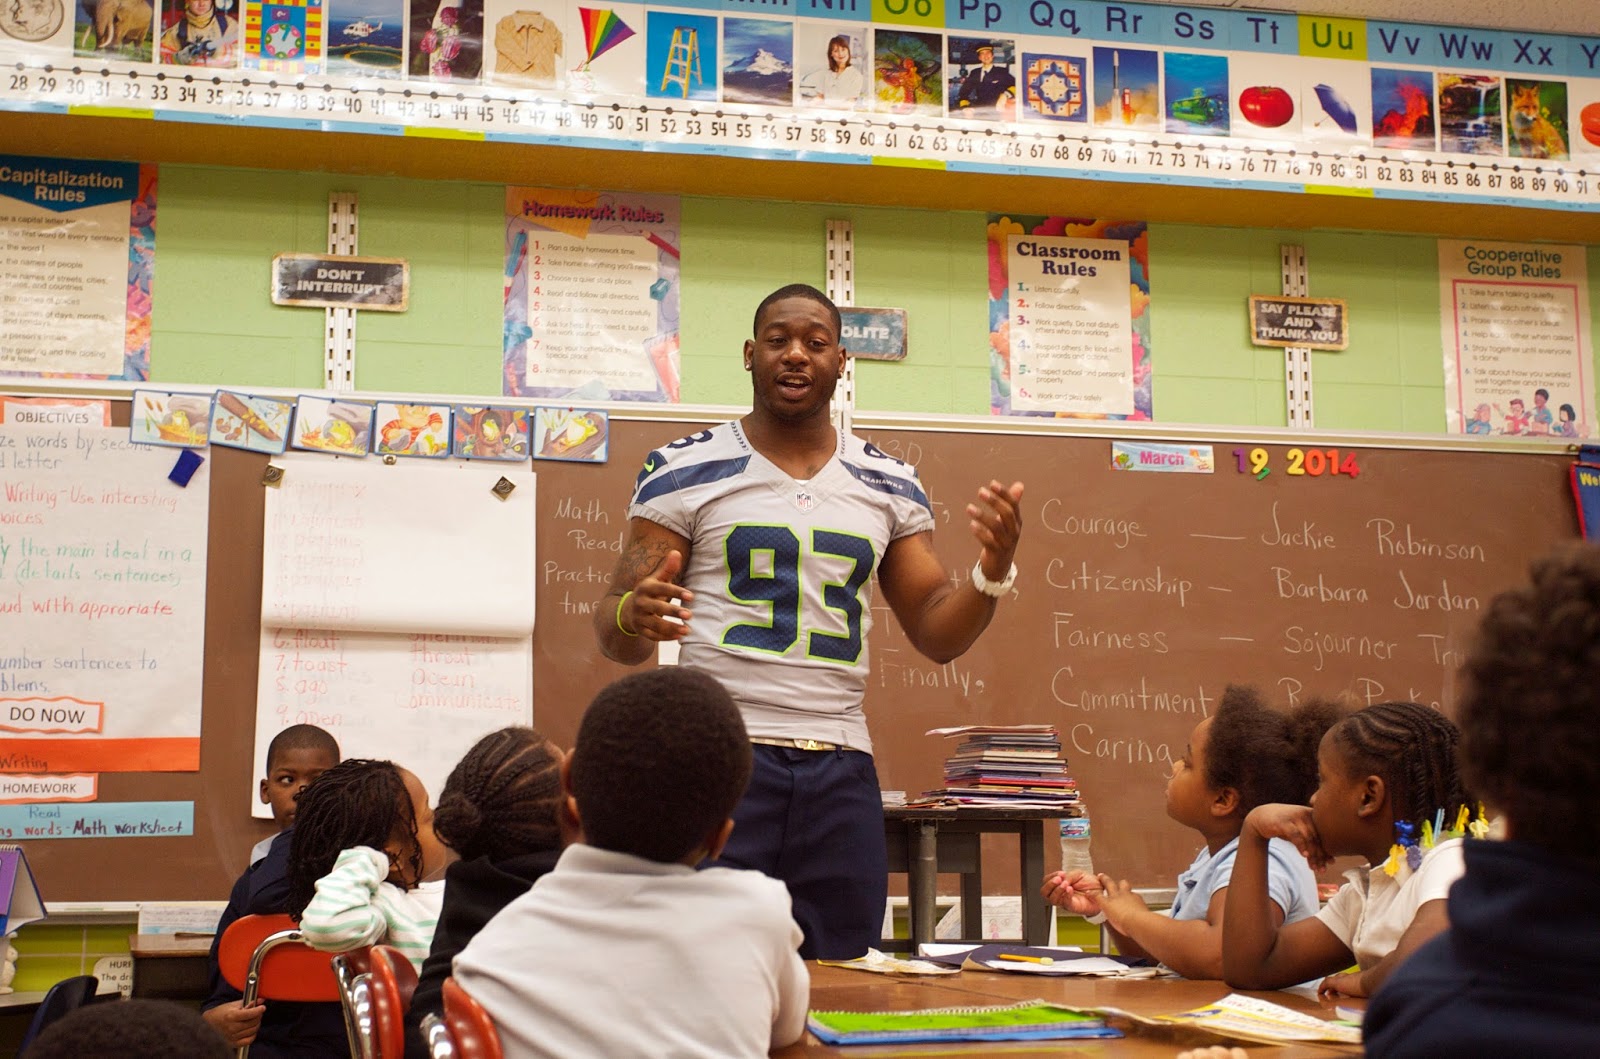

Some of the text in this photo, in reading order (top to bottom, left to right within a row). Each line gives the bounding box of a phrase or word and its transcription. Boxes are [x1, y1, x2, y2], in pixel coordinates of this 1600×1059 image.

[959, 0, 1002, 28] Pp
[1030, 0, 1081, 35] Qq
[1106, 6, 1143, 33] Rr
[1174, 12, 1215, 40] Ss
[1247, 17, 1279, 44] Tt
[1312, 22, 1353, 50] Uu
[1378, 28, 1420, 55] Vv
[1440, 33, 1493, 61] Ww
[1513, 38, 1554, 66] Xx
[10, 75, 28, 90] 28
[151, 84, 168, 100] 33
[178, 87, 196, 102] 34
[206, 88, 224, 105] 35
[344, 98, 362, 113] 40
[424, 102, 441, 118] 43
[451, 104, 468, 120] 44
[477, 106, 494, 121] 45
[581, 113, 598, 129] 49
[608, 115, 623, 130] 50
[636, 117, 648, 132] 51
[661, 119, 676, 133] 52
[686, 120, 702, 135] 53
[711, 122, 727, 136] 54
[736, 123, 752, 138] 55
[786, 127, 802, 141] 57
[860, 132, 875, 146] 60
[885, 134, 897, 148] 61
[909, 135, 924, 150] 62
[933, 136, 948, 151] 63
[1030, 144, 1045, 158] 67
[1054, 146, 1069, 160] 68
[1078, 147, 1092, 162] 69
[1378, 167, 1392, 181] 82
[1400, 168, 1414, 182] 83
[1422, 170, 1437, 185] 84
[1444, 172, 1458, 185] 85
[1466, 173, 1480, 187] 86
[1488, 174, 1502, 188] 87
[1510, 176, 1525, 190] 88
[1532, 178, 1546, 192] 89
[1554, 179, 1568, 193] 90
[1577, 180, 1587, 194] 91
[0, 166, 124, 188] Capitalization
[35, 185, 86, 202] Rules
[523, 200, 664, 224] Homework Rules
[1016, 242, 1121, 261] Classroom
[1464, 246, 1562, 264] Cooperative
[316, 268, 365, 280] DON'T
[1042, 260, 1097, 277] Rules
[1468, 261, 1562, 279] Group Rules
[297, 280, 384, 294] INTERRUPT
[1260, 304, 1337, 317] SAY PLEASE
[1284, 317, 1313, 328] AND
[841, 326, 890, 339] OLITE
[1260, 328, 1338, 341] THANK YOU
[15, 412, 89, 424] OBJECTIVES
[26, 432, 68, 448] words
[76, 428, 94, 460] by
[14, 452, 62, 470] letter
[1140, 451, 1184, 465] March
[1286, 448, 1361, 477] 2014
[860, 474, 904, 490] SEAHAWKS
[554, 498, 608, 525] Math
[1042, 498, 1484, 562] Courage Jackie Robinson
[22, 538, 49, 558] the
[57, 544, 95, 558] main
[158, 549, 174, 560] in
[181, 549, 192, 562] a
[567, 530, 623, 554] Read
[544, 561, 612, 584] Practic
[1046, 558, 1480, 611] Citizenship Barbara Jordan
[720, 522, 876, 666] 93
[32, 596, 74, 613] with
[1053, 612, 1169, 653] Fairness
[1284, 626, 1398, 671] Sojourner
[0, 648, 157, 670] umber sentences to
[1051, 666, 1214, 718] Commitment
[10, 707, 86, 723] DO NOW
[1072, 724, 1175, 779] Caring
[3, 784, 76, 793] HOMEWORK
[26, 806, 60, 818] Read
[101, 973, 116, 981] The
